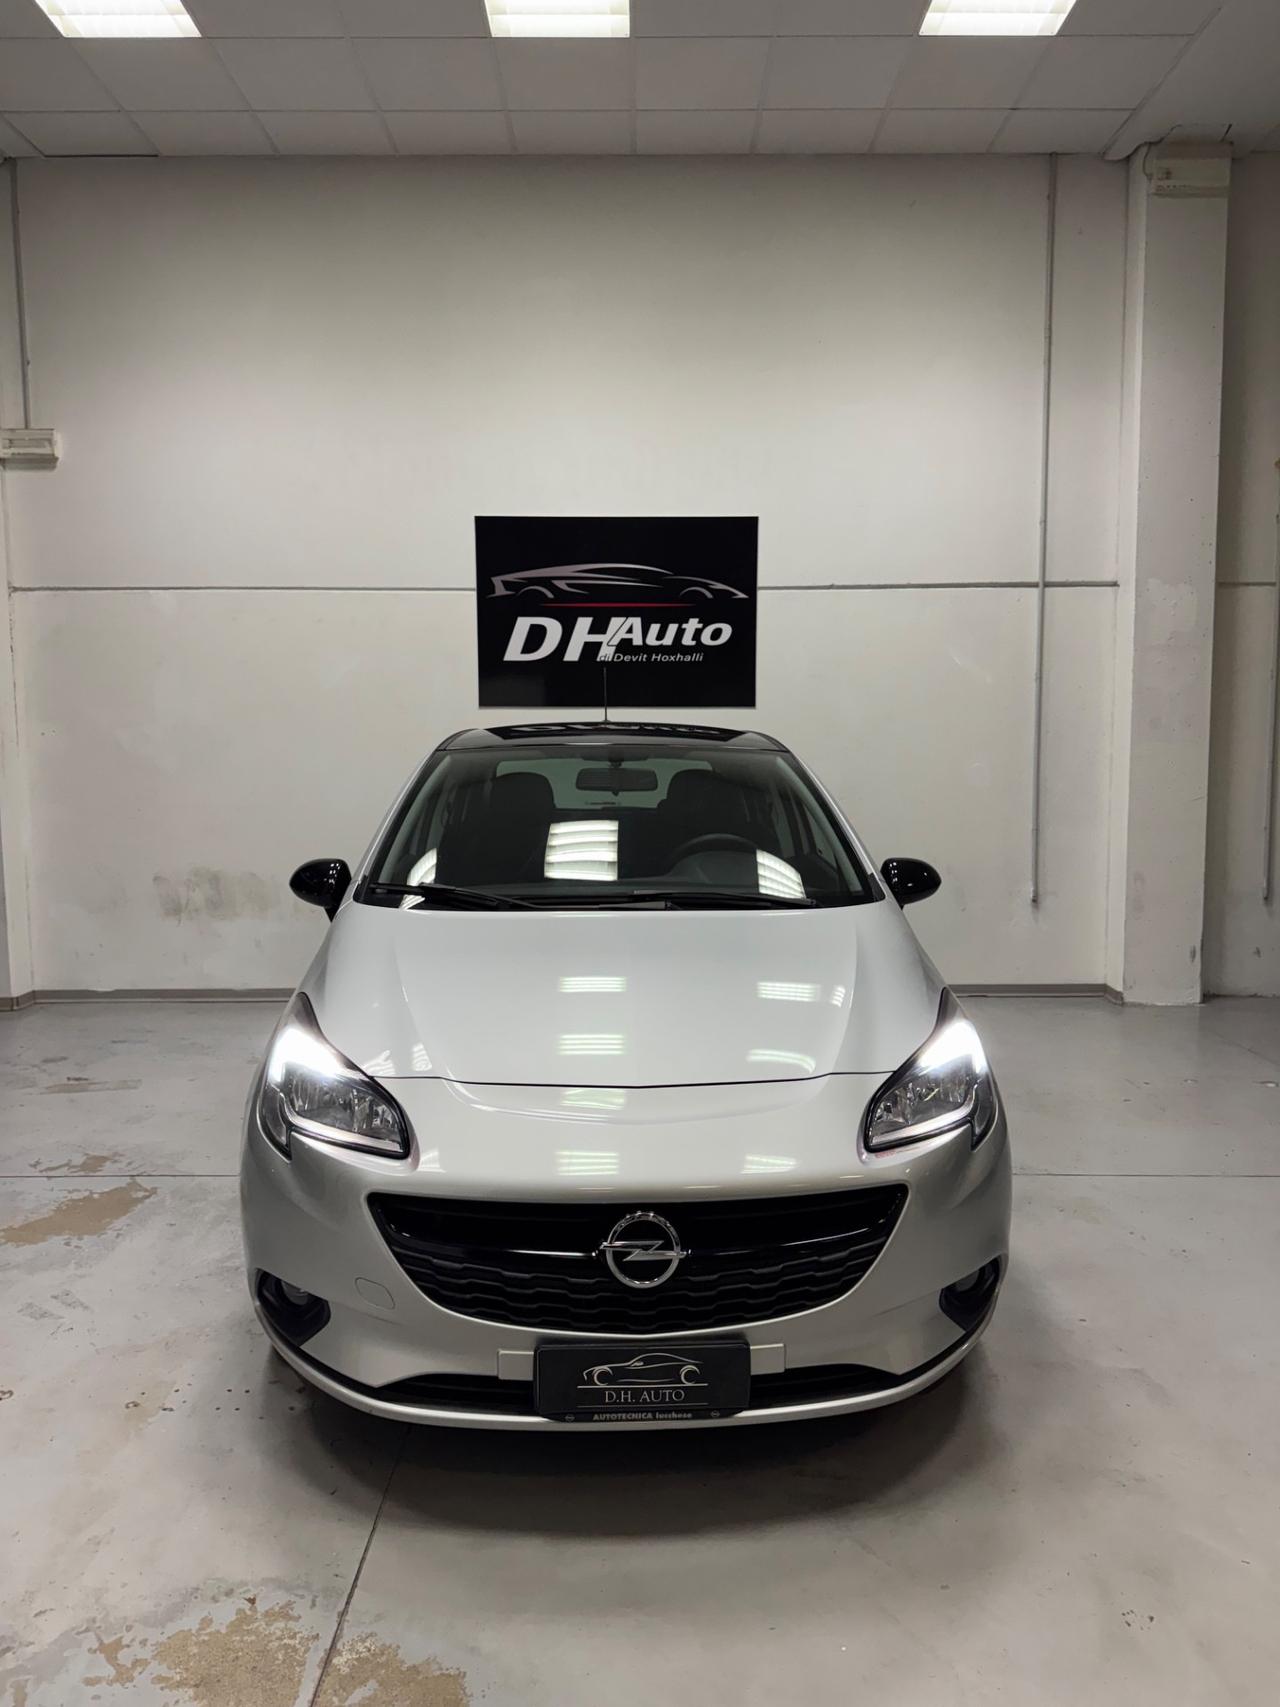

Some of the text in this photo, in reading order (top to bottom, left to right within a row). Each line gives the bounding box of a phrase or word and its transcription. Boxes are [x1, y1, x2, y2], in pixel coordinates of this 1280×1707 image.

[607, 616, 733, 647] Auto
[613, 652, 648, 662] Devit
[651, 652, 705, 662] Hoxhalli
[604, 1389, 686, 1404] D.H. AUTO
[592, 1412, 654, 1421] AUTOTECNICA
